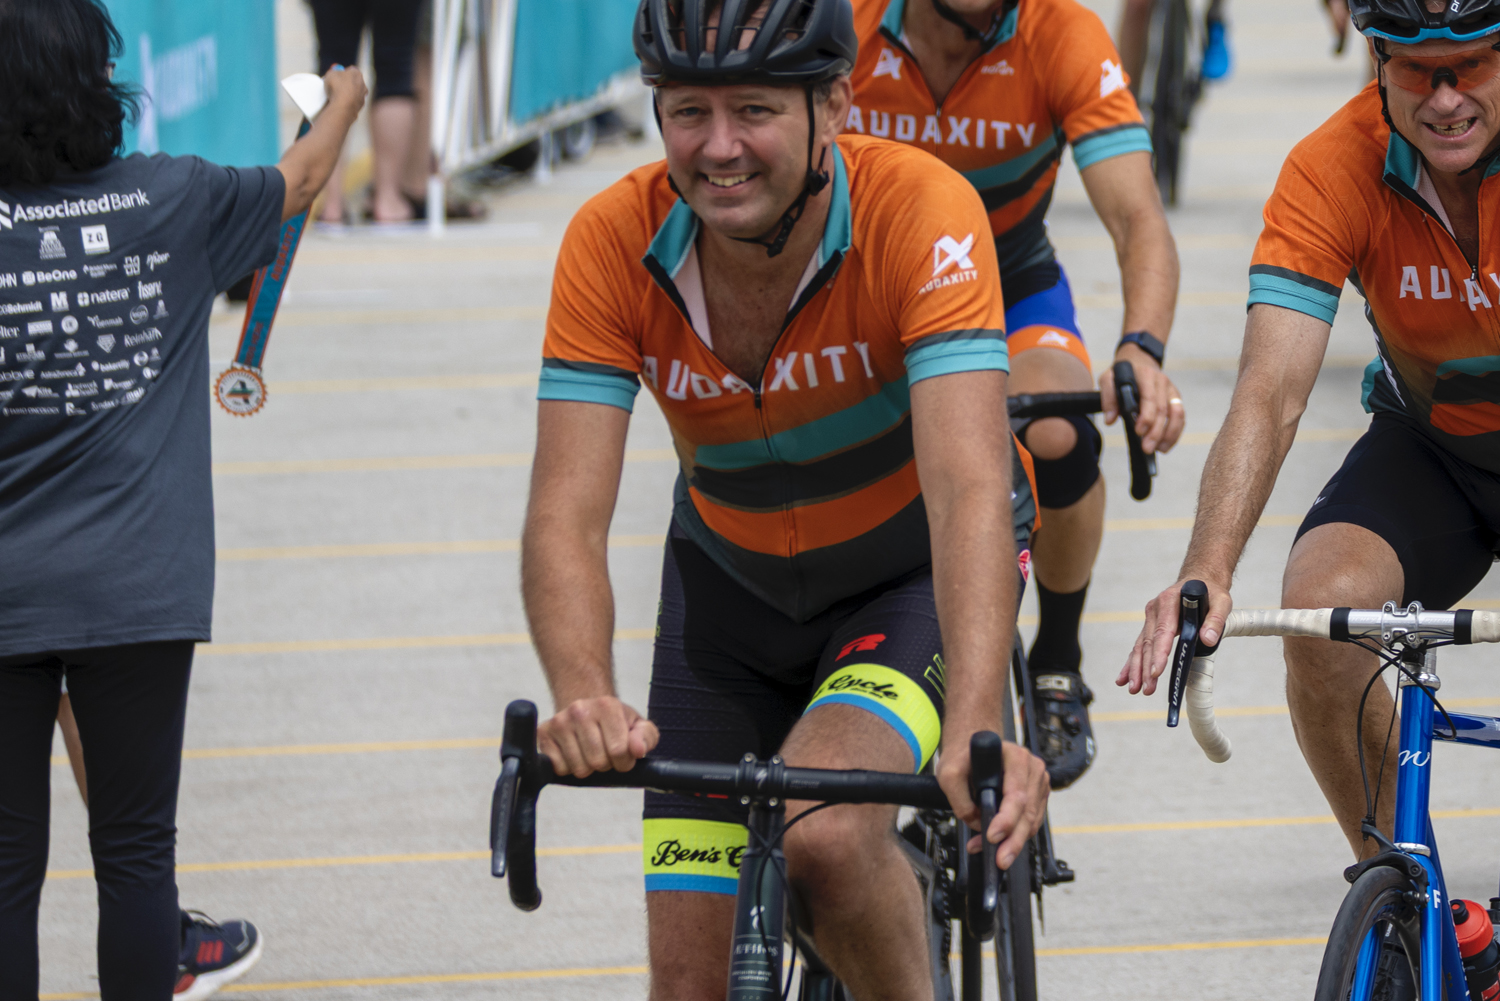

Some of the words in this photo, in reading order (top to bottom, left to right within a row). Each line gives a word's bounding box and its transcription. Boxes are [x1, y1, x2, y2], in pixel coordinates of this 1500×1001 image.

[845, 104, 1036, 149] AUDAXITY
[828, 674, 898, 700] Cycle
[1172, 642, 1188, 707] ULTEGRA
[651, 839, 722, 867] Ben's
